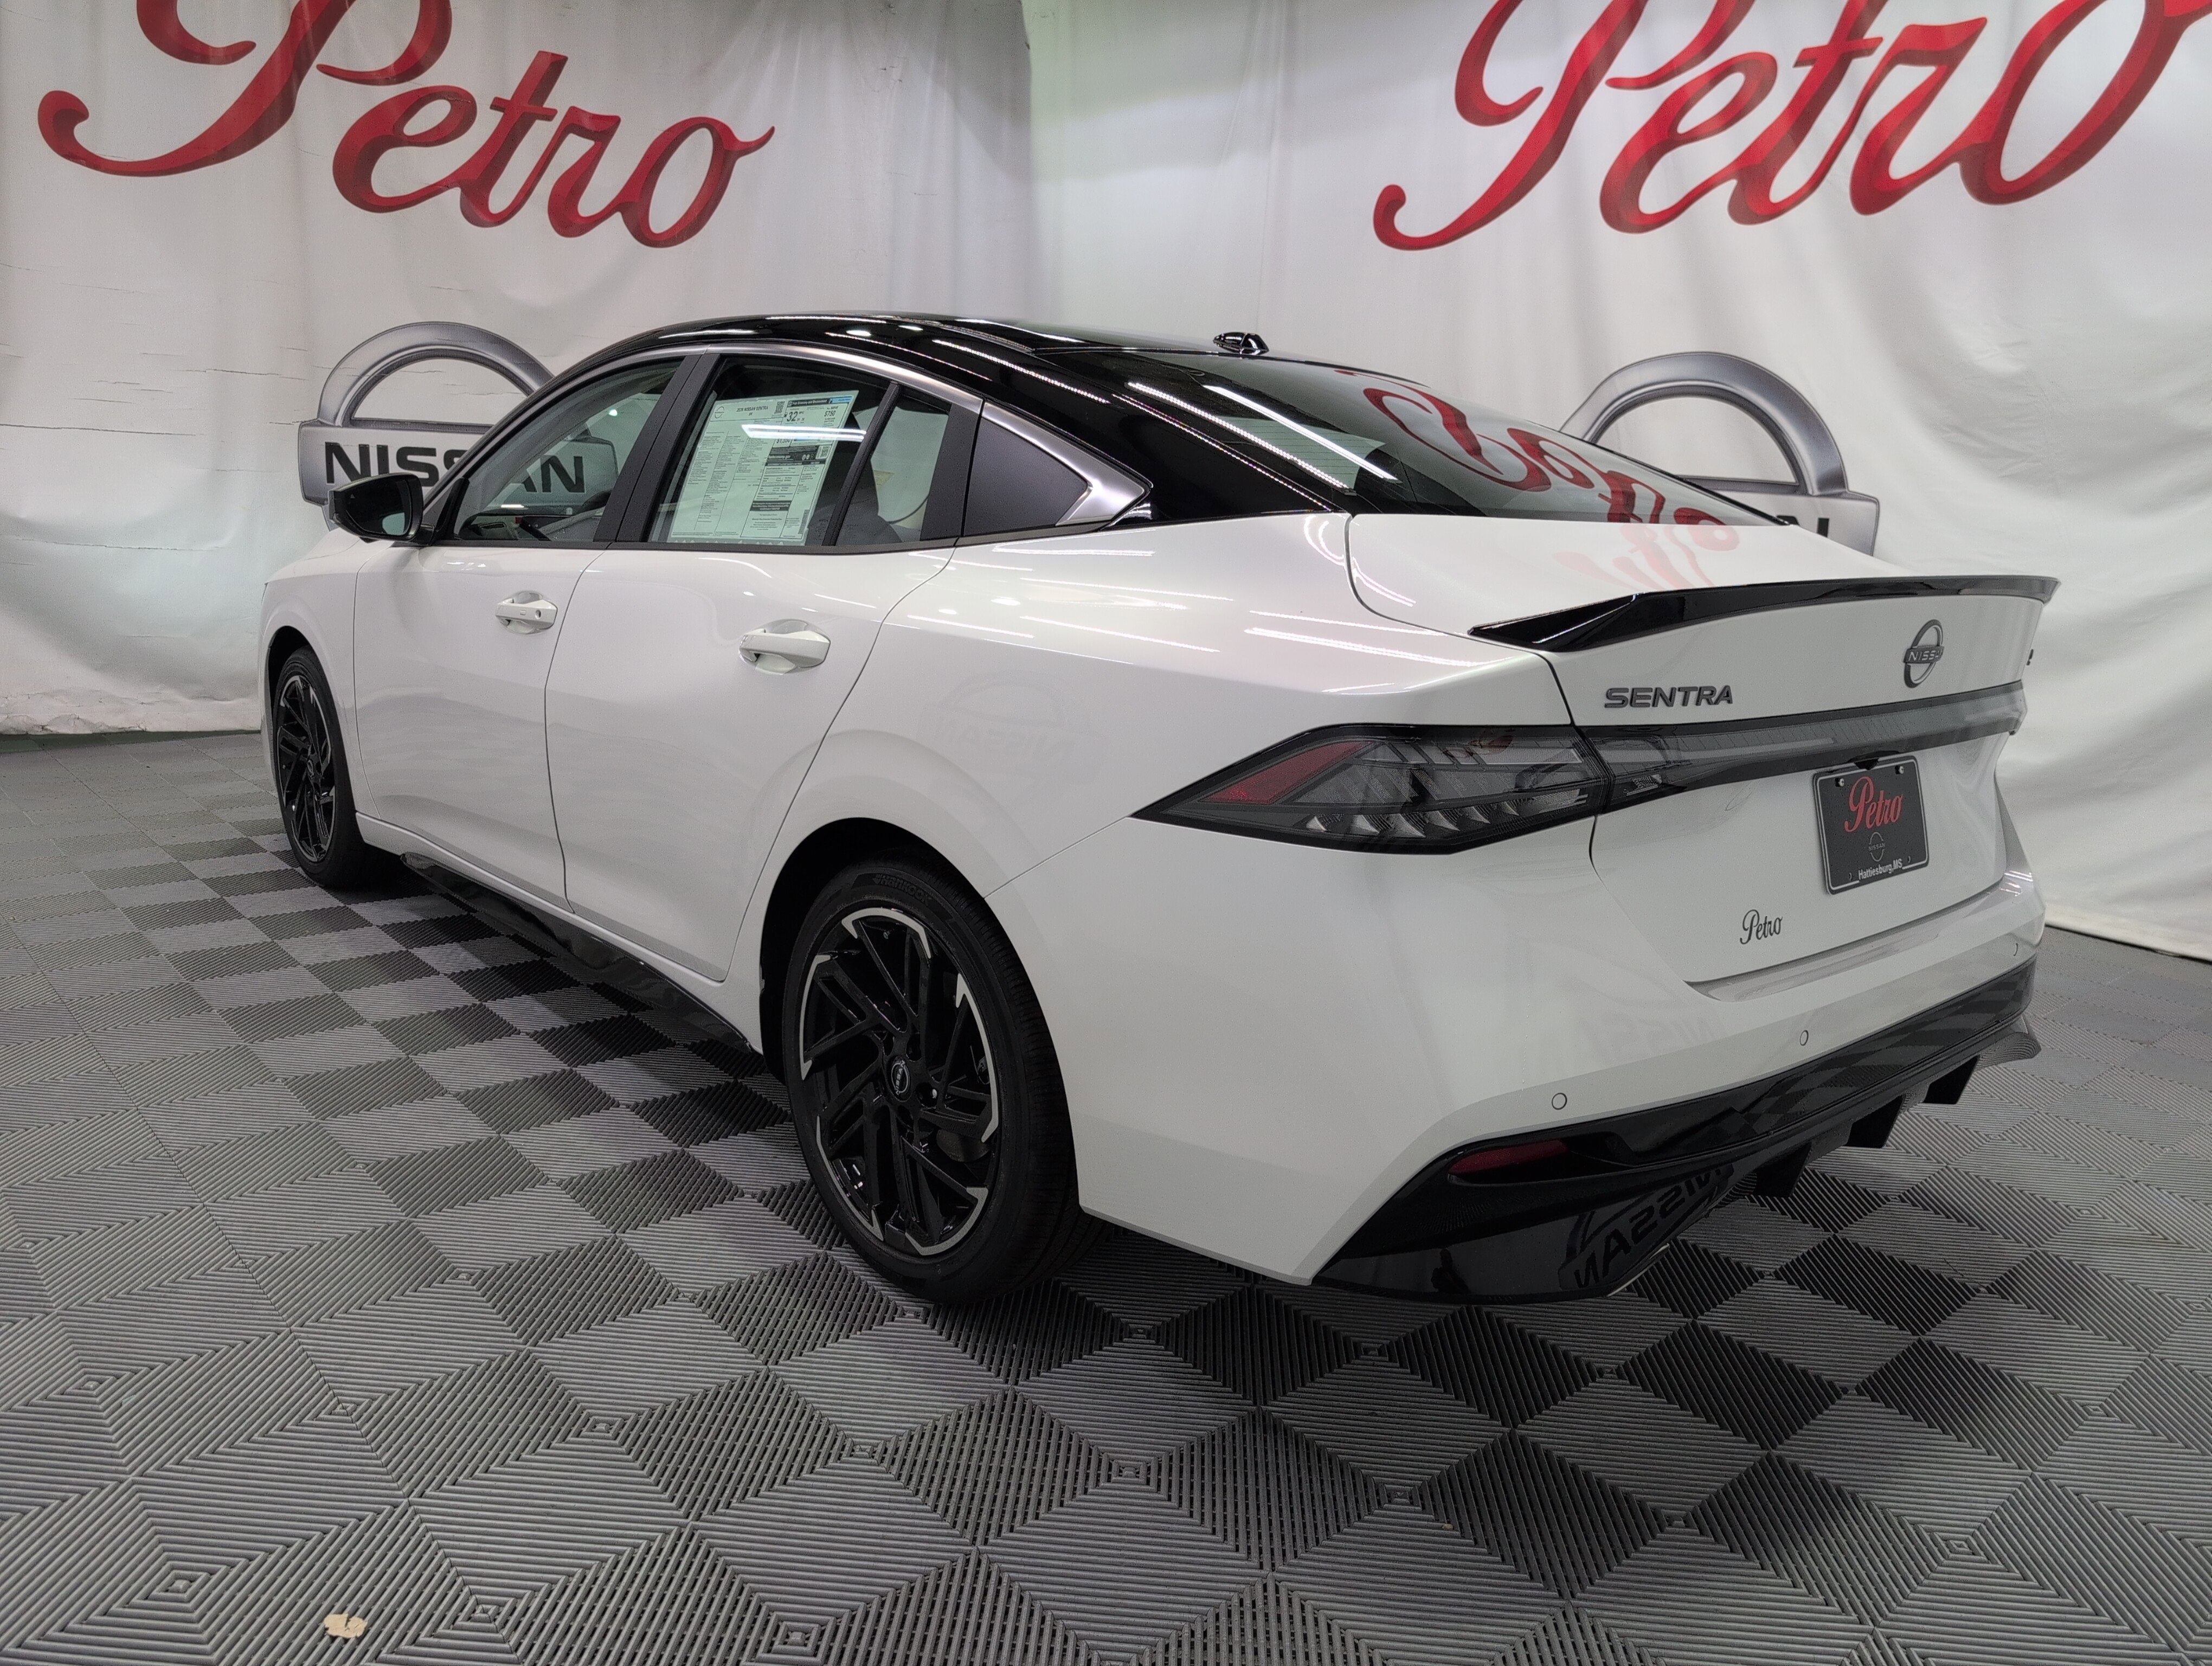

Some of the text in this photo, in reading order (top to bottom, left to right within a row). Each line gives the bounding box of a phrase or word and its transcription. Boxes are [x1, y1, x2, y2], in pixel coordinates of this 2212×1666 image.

[37, 0, 775, 248] Petro
[1373, 0, 2212, 251] Petro
[787, 411, 798, 421] 32
[1604, 684, 1733, 709] SENTRA
[1844, 776, 1903, 832] Petro
[1868, 842, 1886, 852] NISSAN
[1739, 909, 1783, 945] Petro
